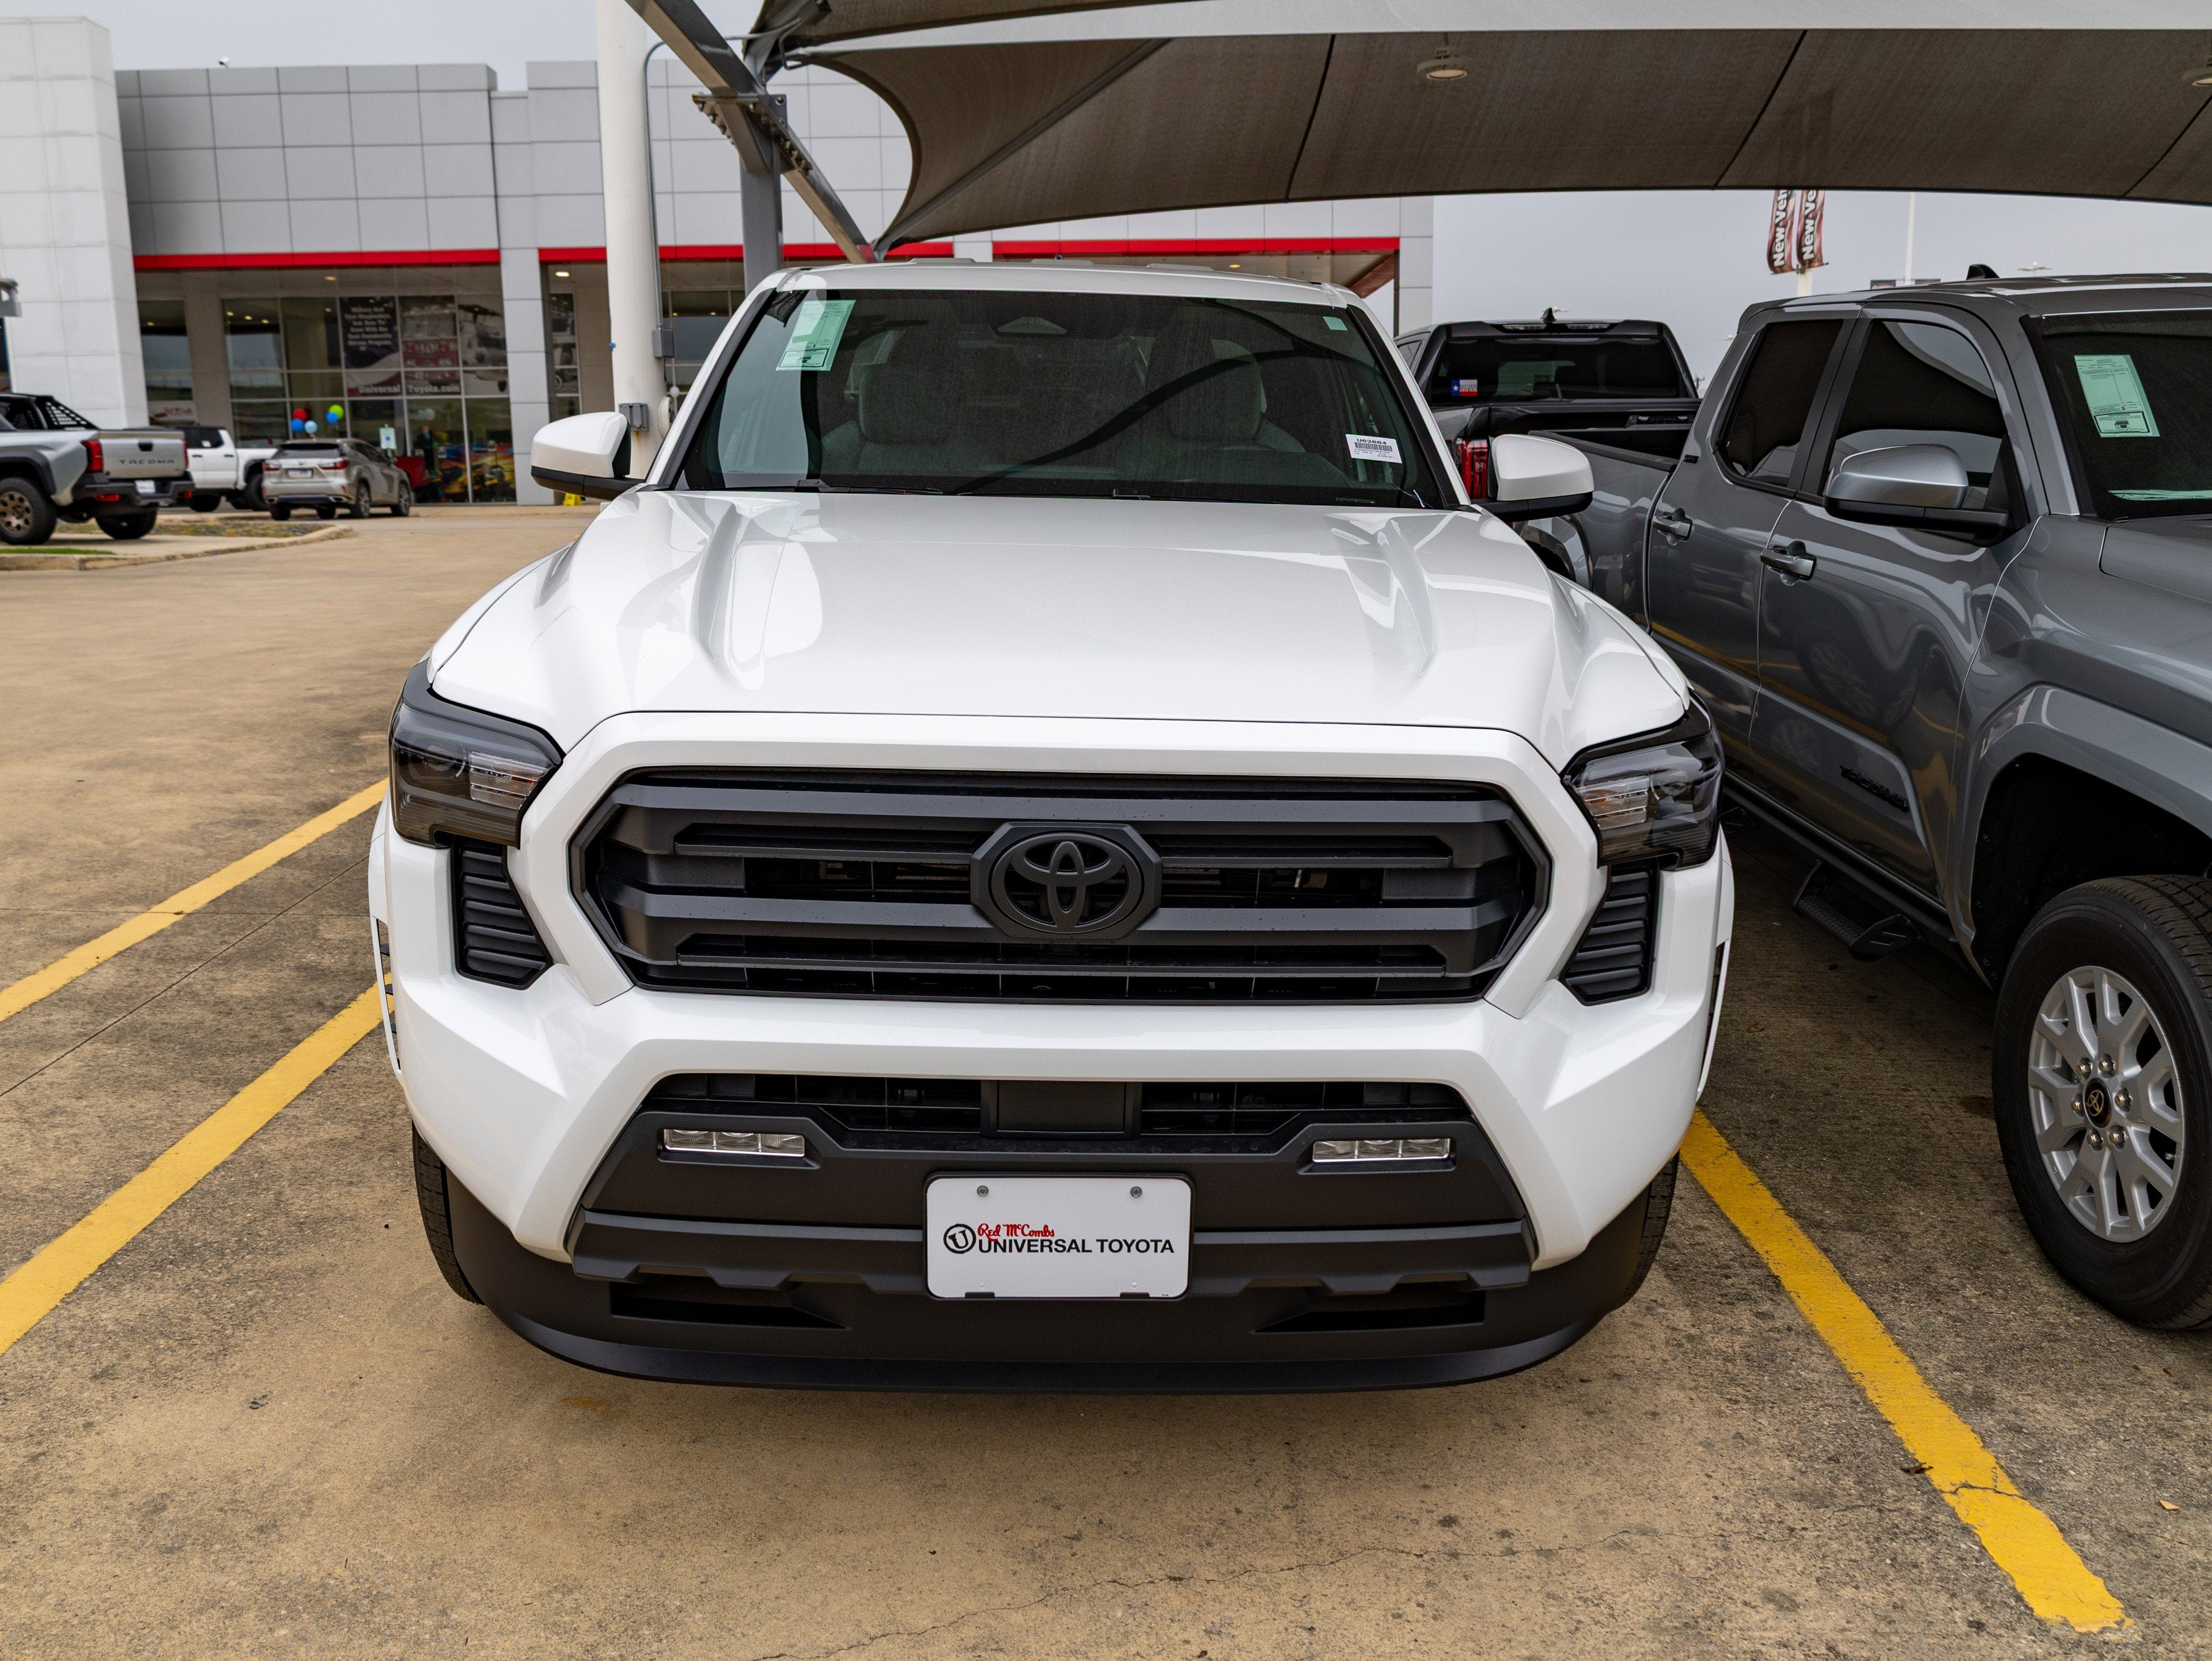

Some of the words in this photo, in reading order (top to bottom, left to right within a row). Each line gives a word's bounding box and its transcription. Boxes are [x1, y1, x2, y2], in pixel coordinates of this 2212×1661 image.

[1775, 190, 1787, 225] Veh
[1805, 190, 1817, 217] Ve
[1773, 227, 1785, 267] New
[1802, 220, 1815, 260] New
[358, 385, 401, 394] Universal
[978, 1223, 1002, 1242] Red
[1002, 1224, 1055, 1238] McCombs
[979, 1239, 1092, 1253] UNIVERSAL
[1096, 1239, 1175, 1253] TOYOTA
